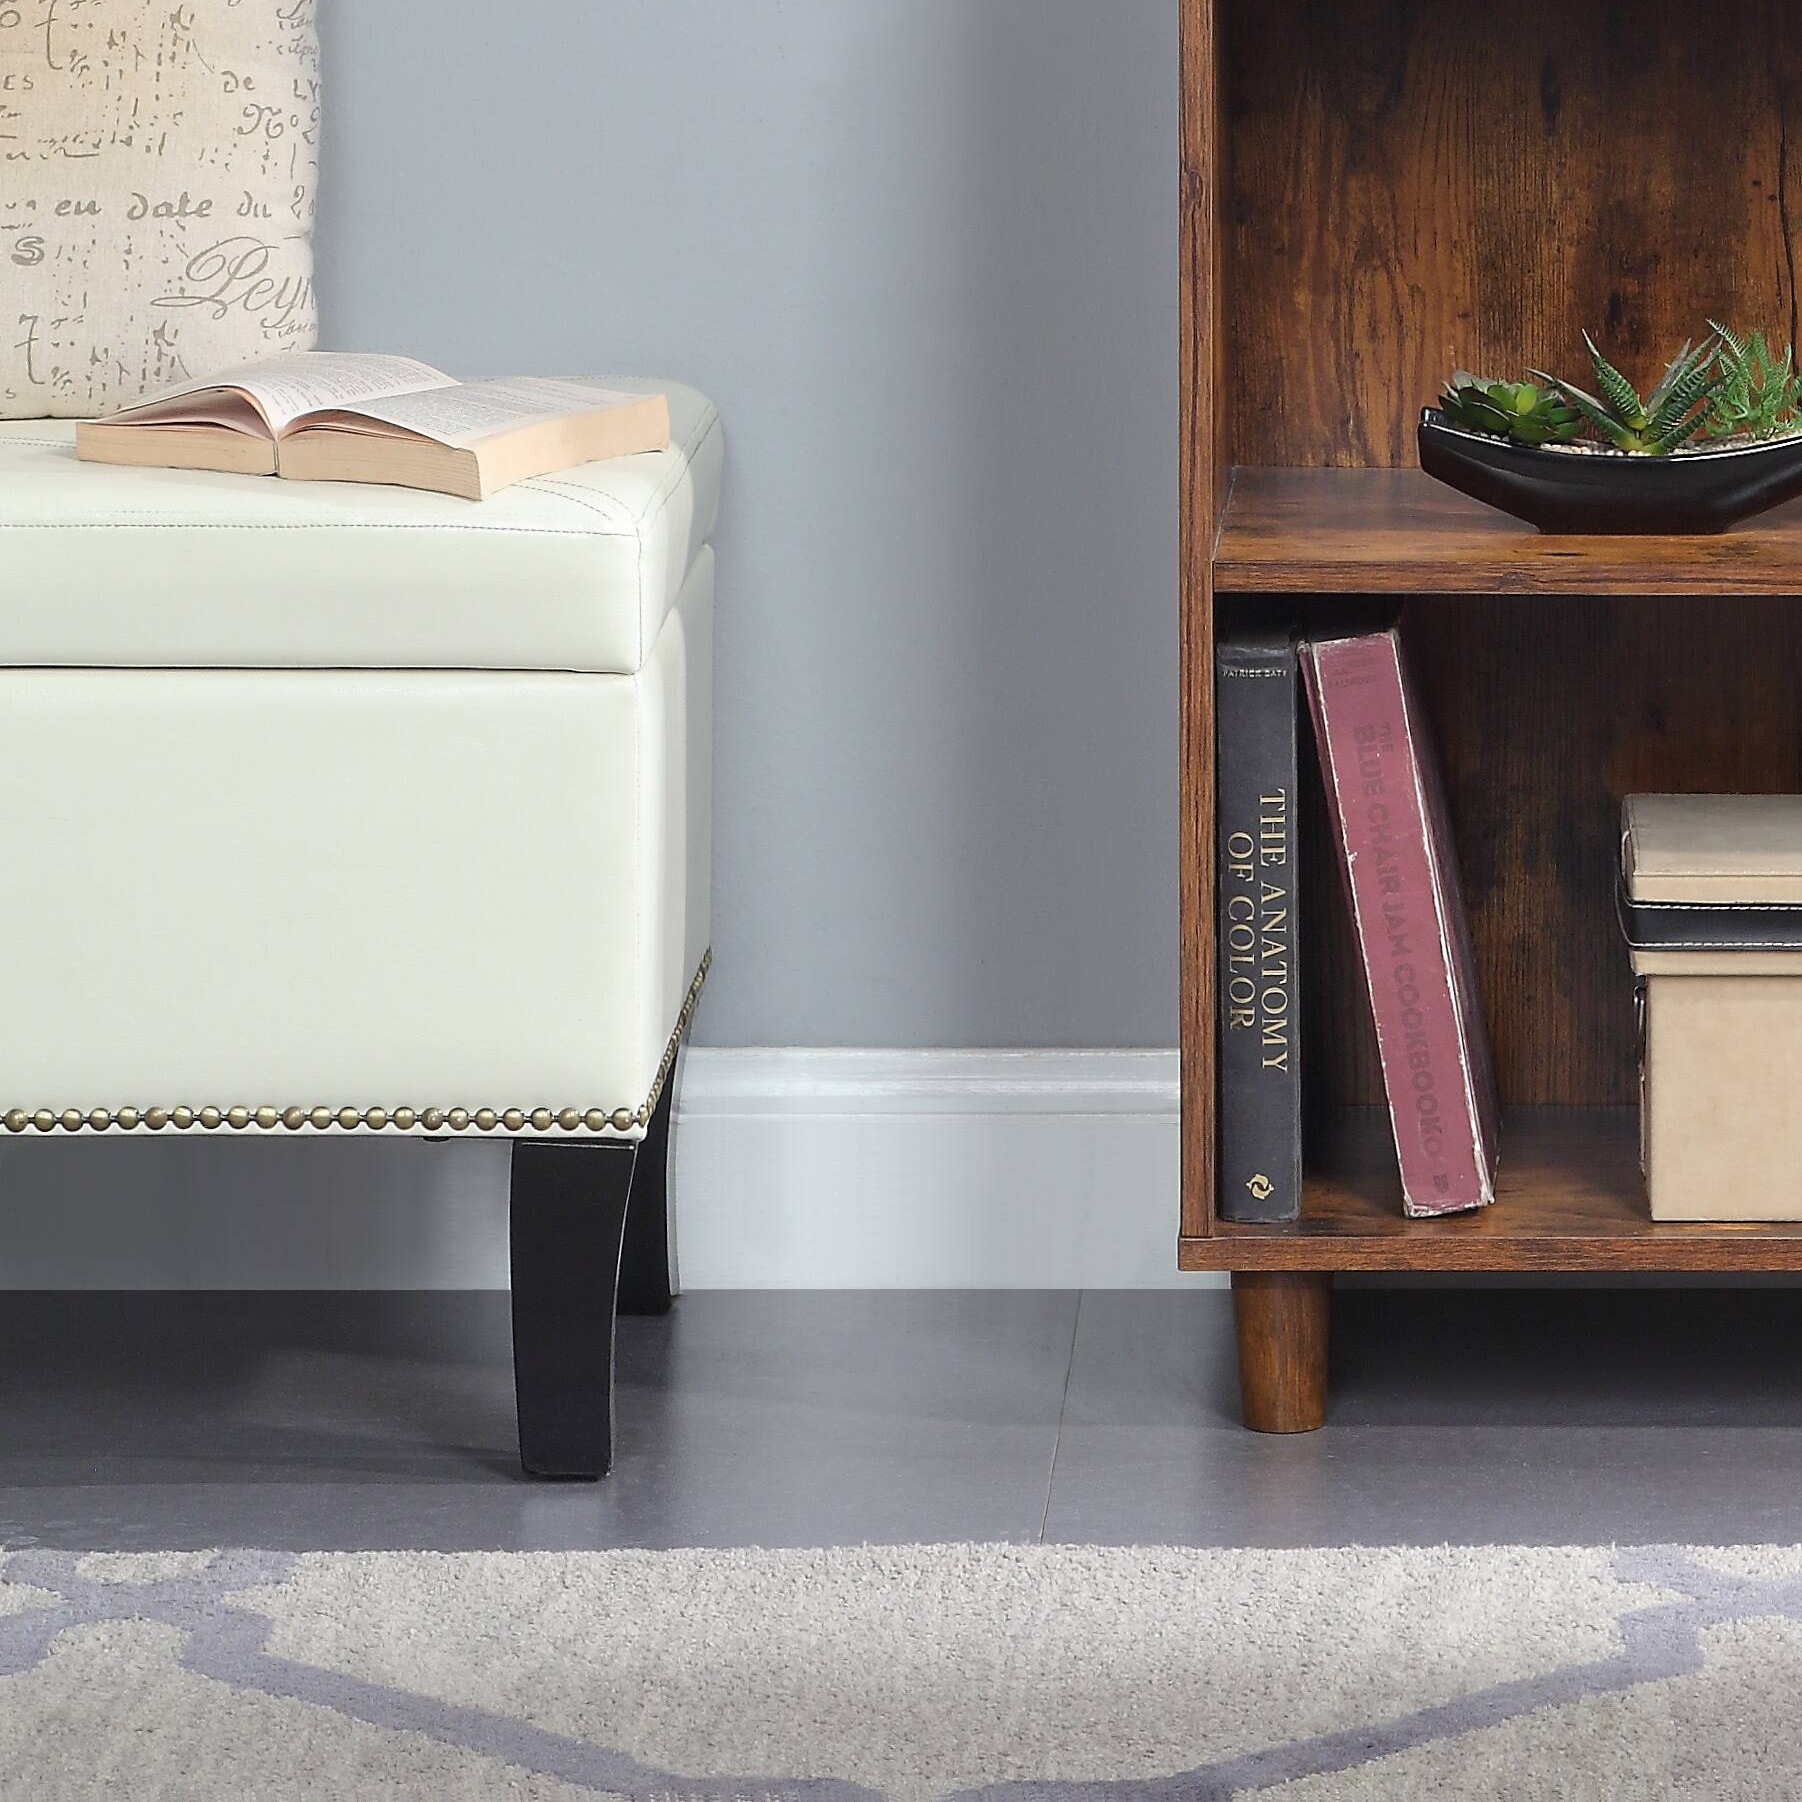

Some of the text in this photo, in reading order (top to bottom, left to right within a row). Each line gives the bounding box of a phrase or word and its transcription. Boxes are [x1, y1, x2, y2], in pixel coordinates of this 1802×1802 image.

[1366, 803, 1400, 896] CHAIR
[1228, 831, 1256, 1031] OF COLOR
[1259, 788, 1289, 1075] THE ANATOMY
[1382, 902, 1411, 957] JAM
